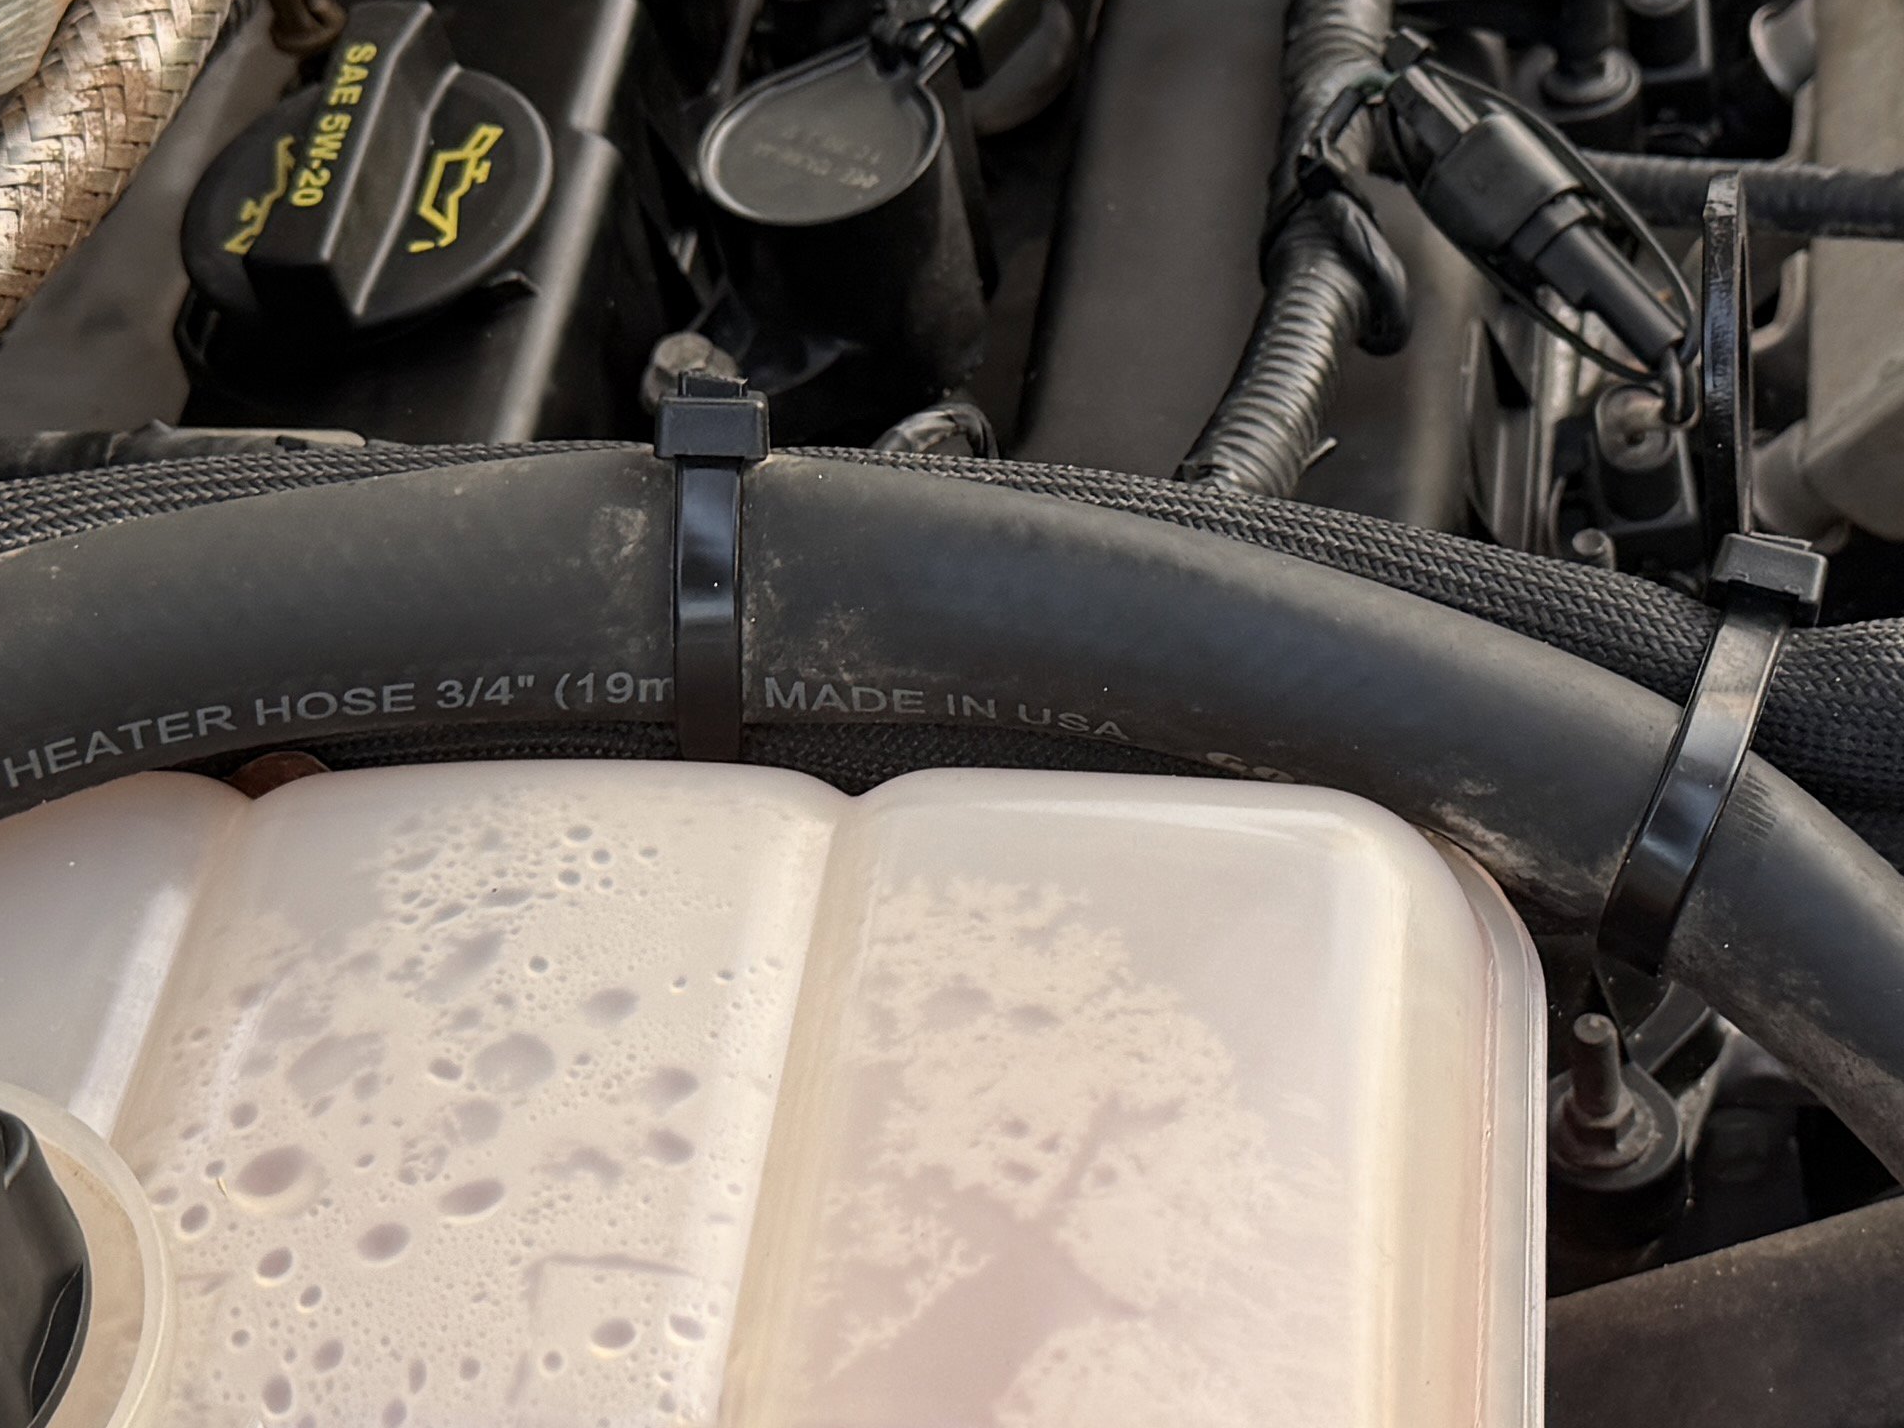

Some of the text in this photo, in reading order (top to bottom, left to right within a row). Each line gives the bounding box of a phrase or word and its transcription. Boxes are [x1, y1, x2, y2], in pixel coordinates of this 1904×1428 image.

[289, 41, 378, 208] SAE 5W-20
[1, 703, 239, 789] HEATER
[254, 682, 418, 728] HOSE
[436, 673, 536, 712] 3/4"
[763, 675, 1132, 742] MADE IN USA
